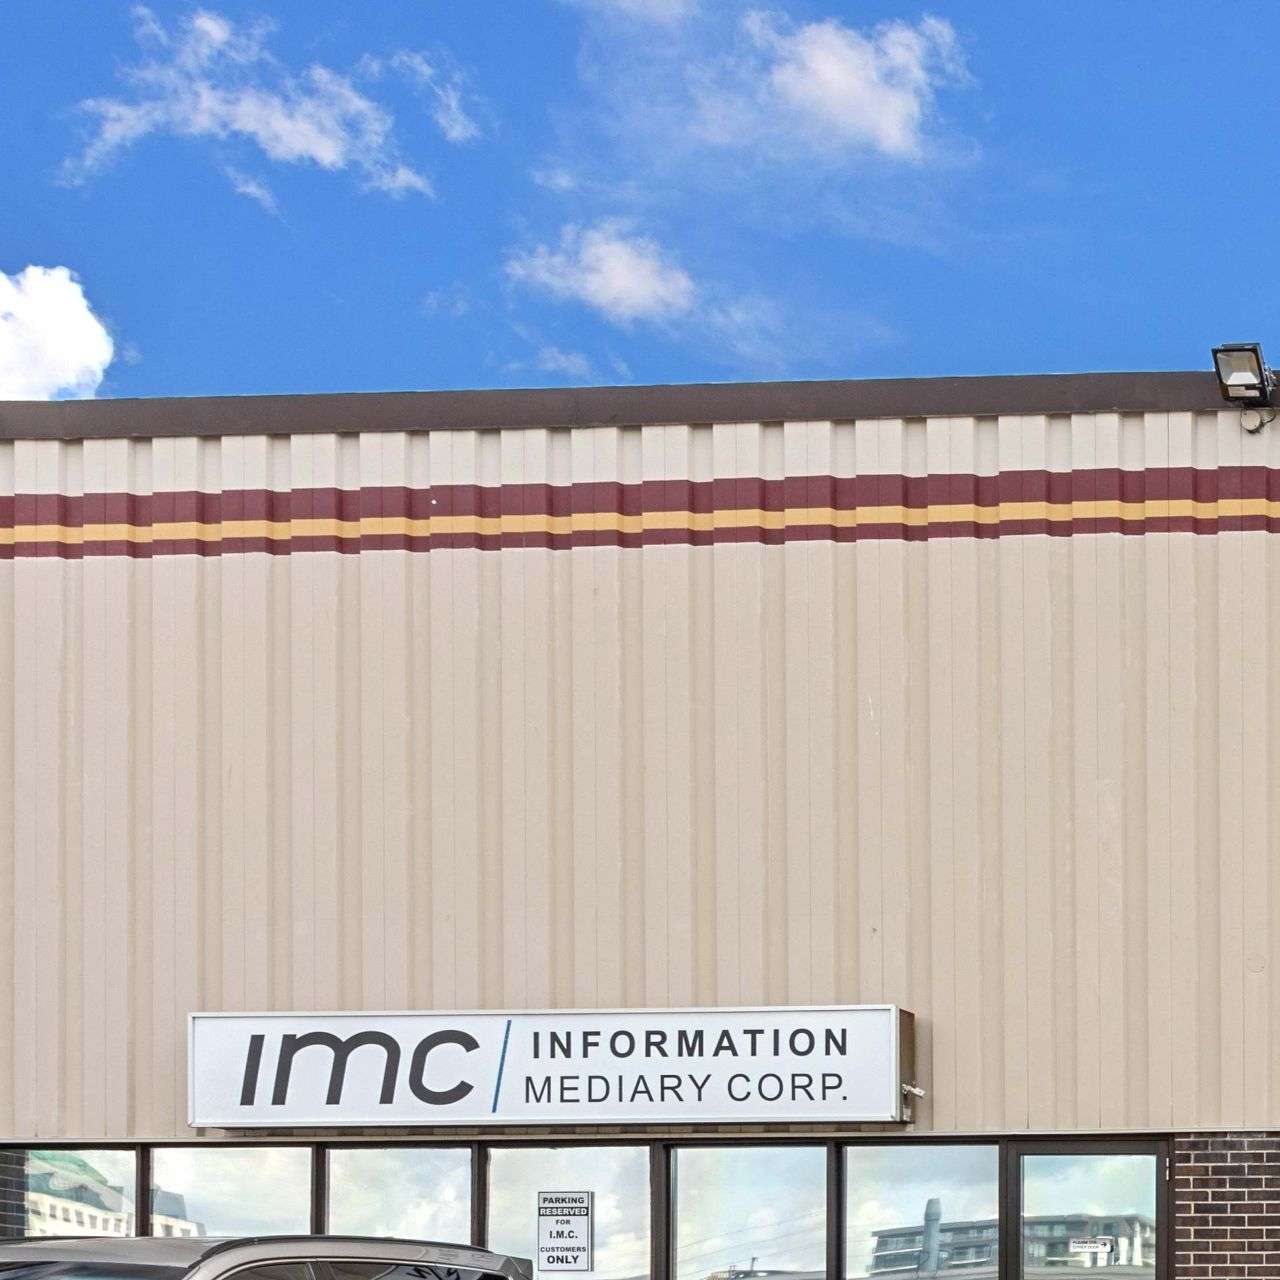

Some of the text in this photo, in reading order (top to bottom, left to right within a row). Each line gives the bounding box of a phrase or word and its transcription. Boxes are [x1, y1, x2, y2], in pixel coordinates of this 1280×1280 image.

[533, 1028, 848, 1059] INFORMATION
[525, 1072, 848, 1104] MEDIARY CORP.
[542, 1196, 584, 1204] PARKING
[549, 1230, 578, 1239] I.M.C.
[546, 1255, 579, 1264] ONLY
